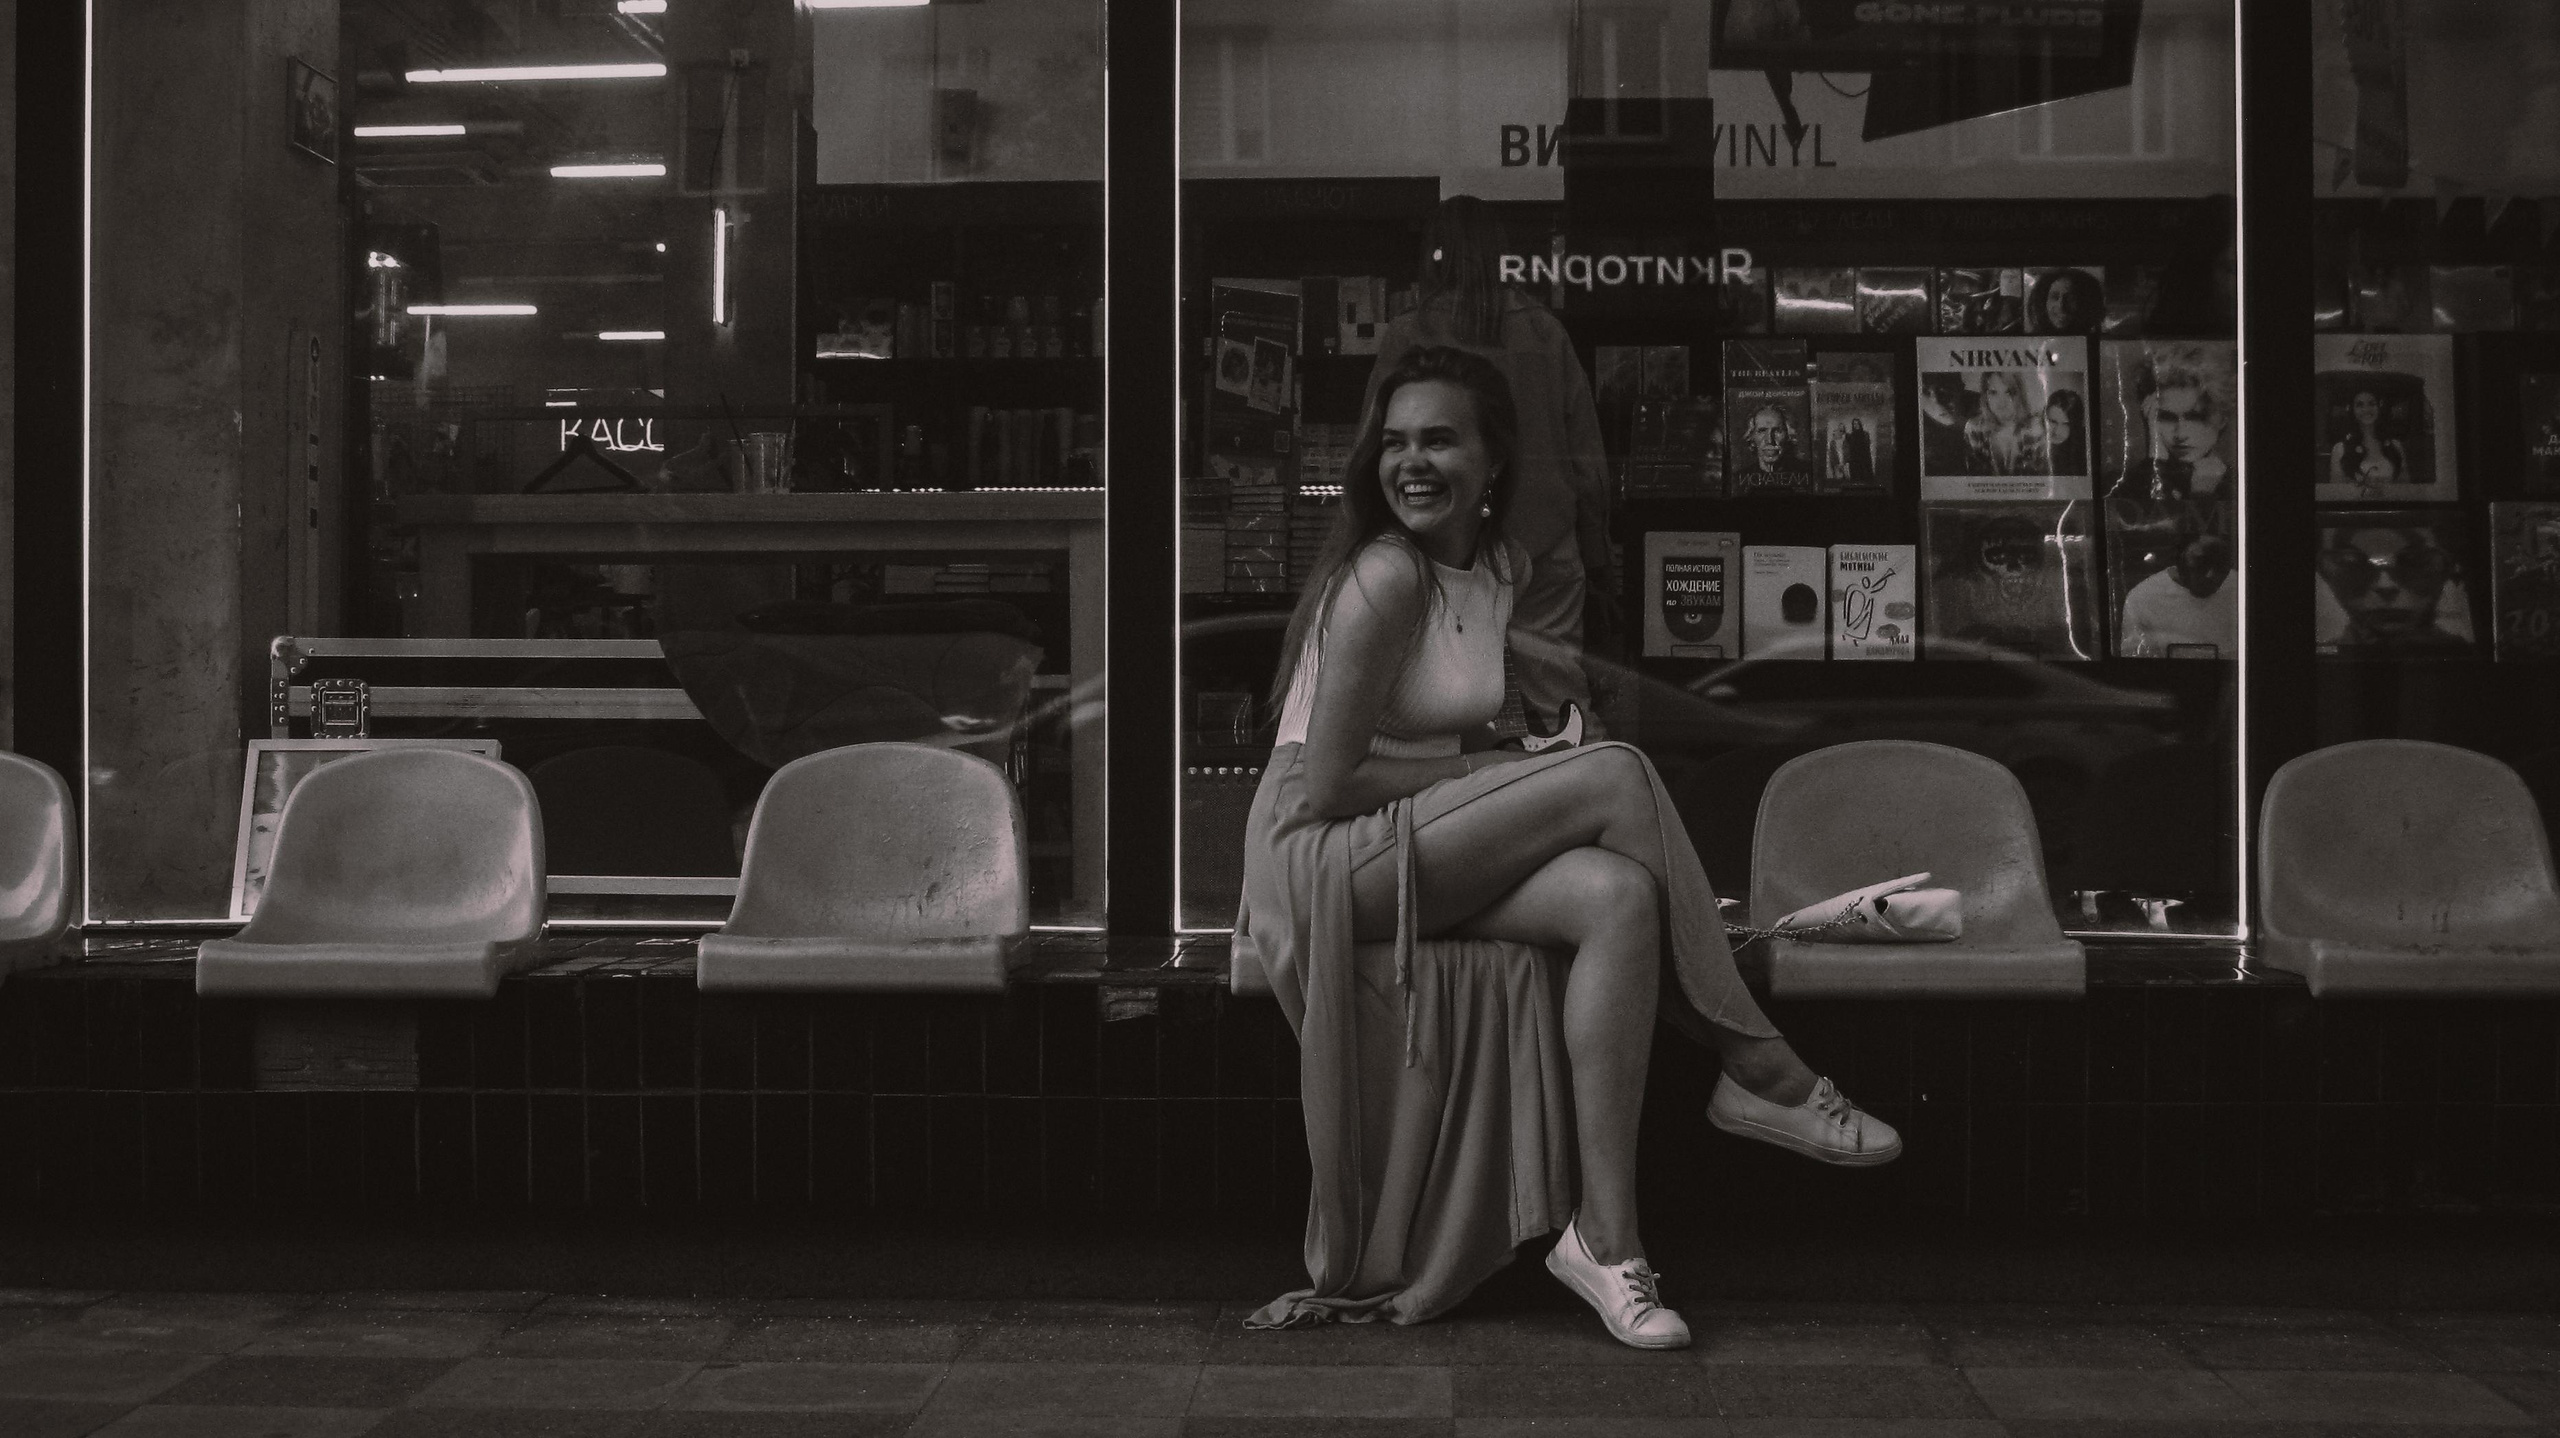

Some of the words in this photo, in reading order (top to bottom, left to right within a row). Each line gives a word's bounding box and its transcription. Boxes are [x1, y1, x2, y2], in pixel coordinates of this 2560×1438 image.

[1950, 349, 2058, 367] NIRVANA
[1738, 472, 1810, 487] ИСКАТЕЛИ
[1665, 563, 1692, 573] ПОЛНАЯ
[1692, 563, 1722, 574] ИСТОРИЯ
[1840, 561, 1875, 572] МОТИВЫ
[1665, 579, 1721, 593] ХОЖДЕНИЕ
[1680, 594, 1722, 607] ЗВУКАМ
